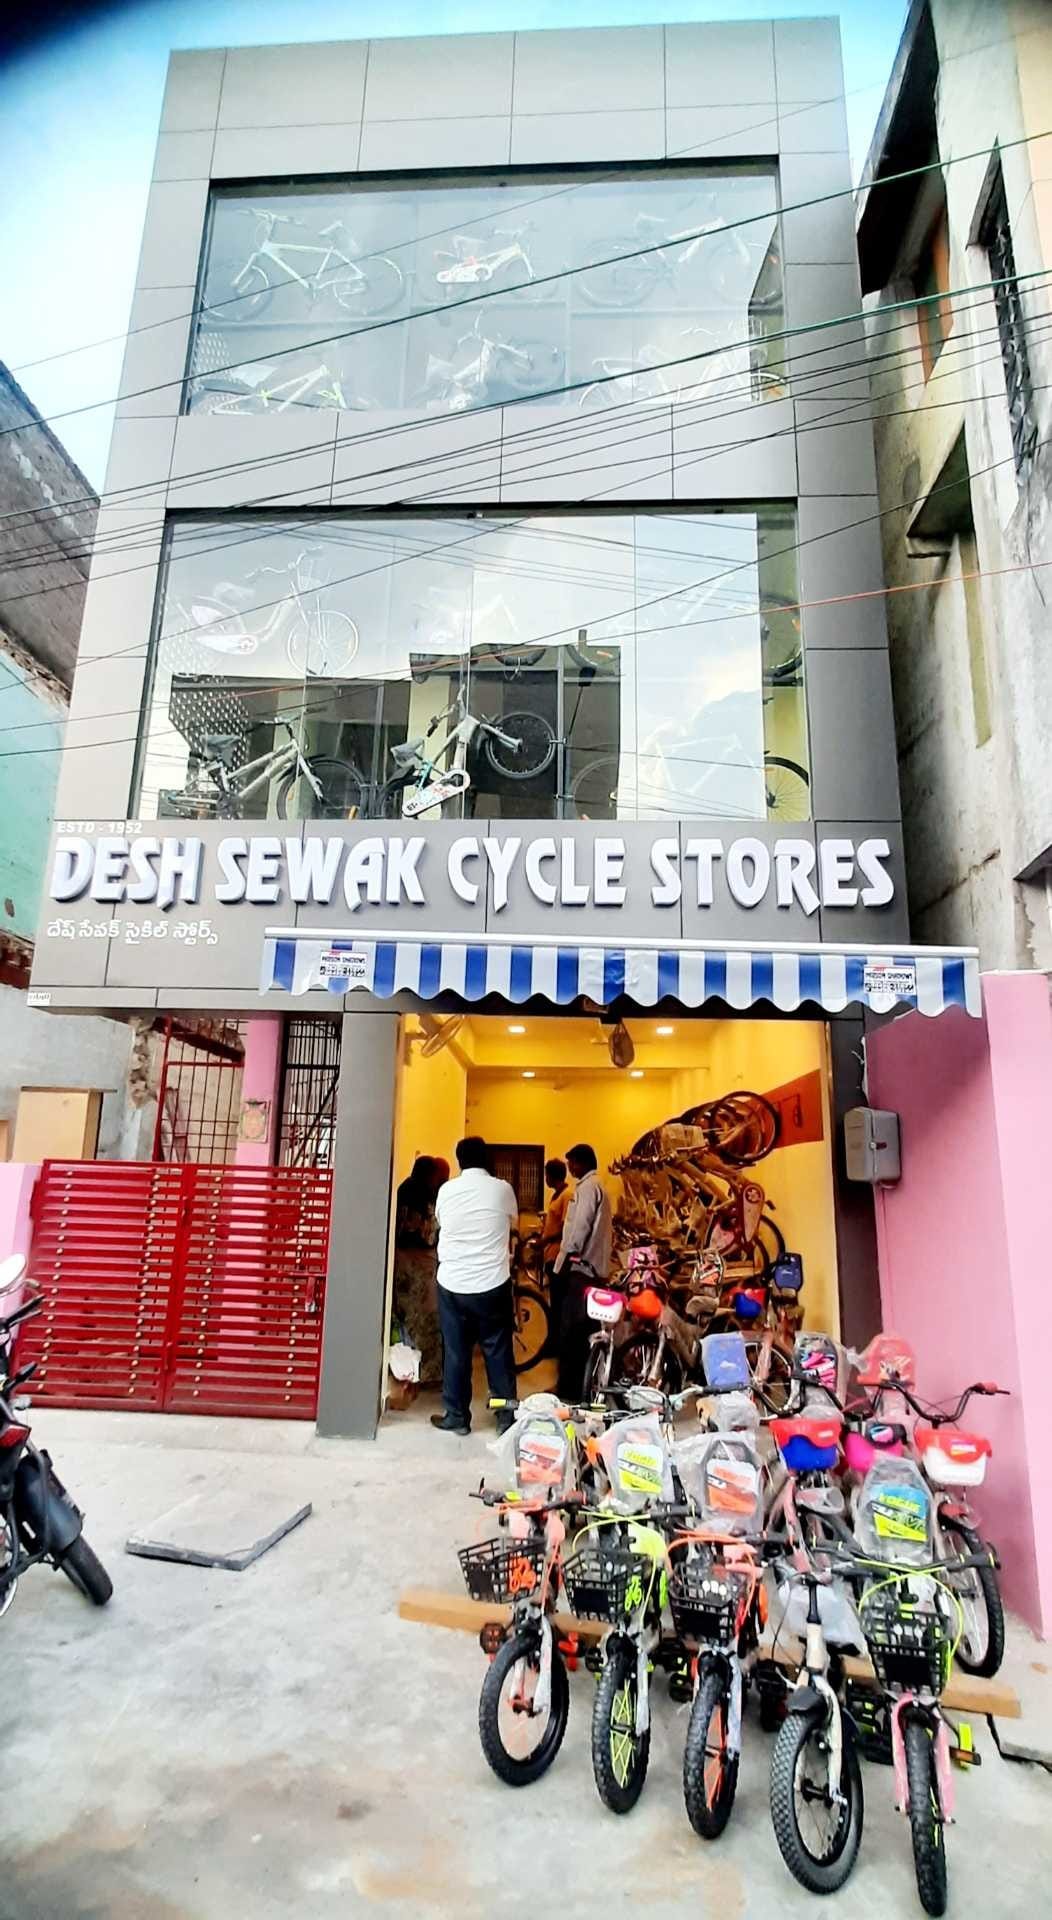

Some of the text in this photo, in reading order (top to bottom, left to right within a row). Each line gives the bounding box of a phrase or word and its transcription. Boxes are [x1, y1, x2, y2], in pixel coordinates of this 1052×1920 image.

[56, 822, 95, 834] ESTD
[108, 822, 143, 834] 1952
[49, 836, 895, 916] DESH SEWAK CYCLE STORES
[47, 918, 219, 945] దేష్ సేవక్ సైకిల్ స్టోర్స్
